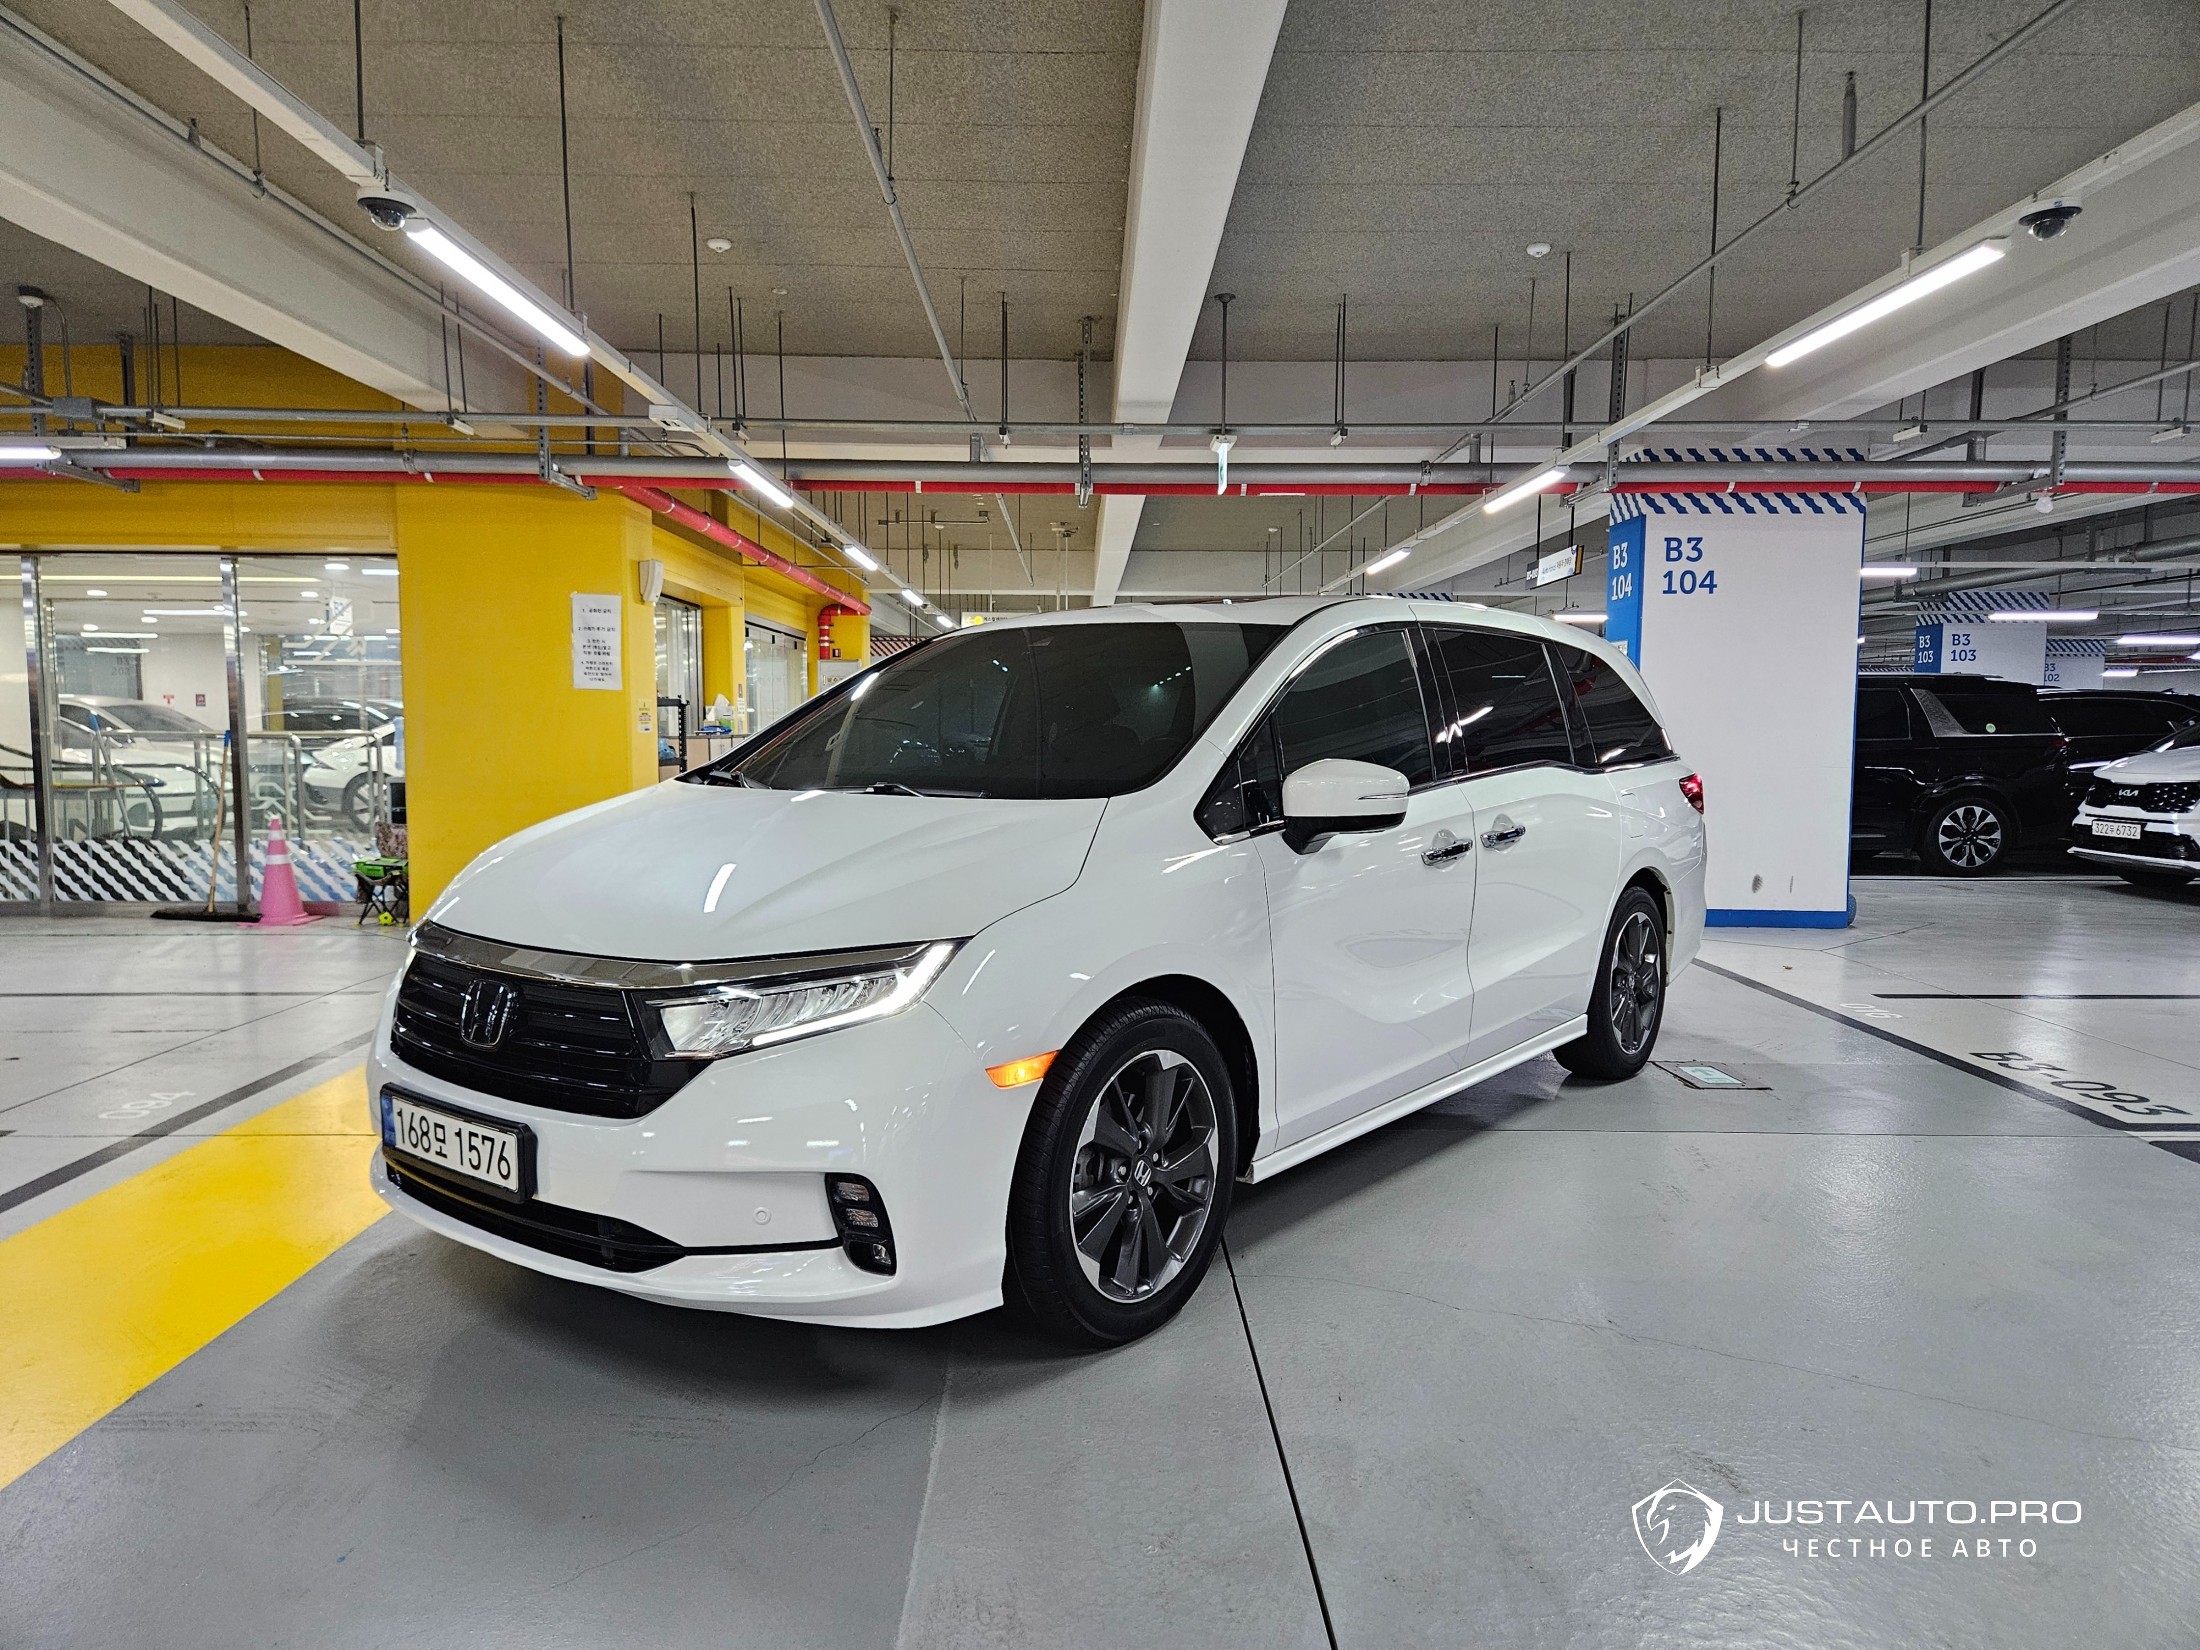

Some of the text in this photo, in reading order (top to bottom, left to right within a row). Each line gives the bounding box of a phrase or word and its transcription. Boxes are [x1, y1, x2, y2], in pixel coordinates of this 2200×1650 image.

[1613, 542, 1628, 570] B3
[1663, 537, 1704, 562] B3
[1611, 573, 1633, 601] 104
[1662, 570, 1718, 594] 104
[1919, 635, 1931, 648] B3
[1952, 633, 1971, 646] B3
[1917, 651, 1934, 663] 103
[1950, 649, 1977, 662] 103
